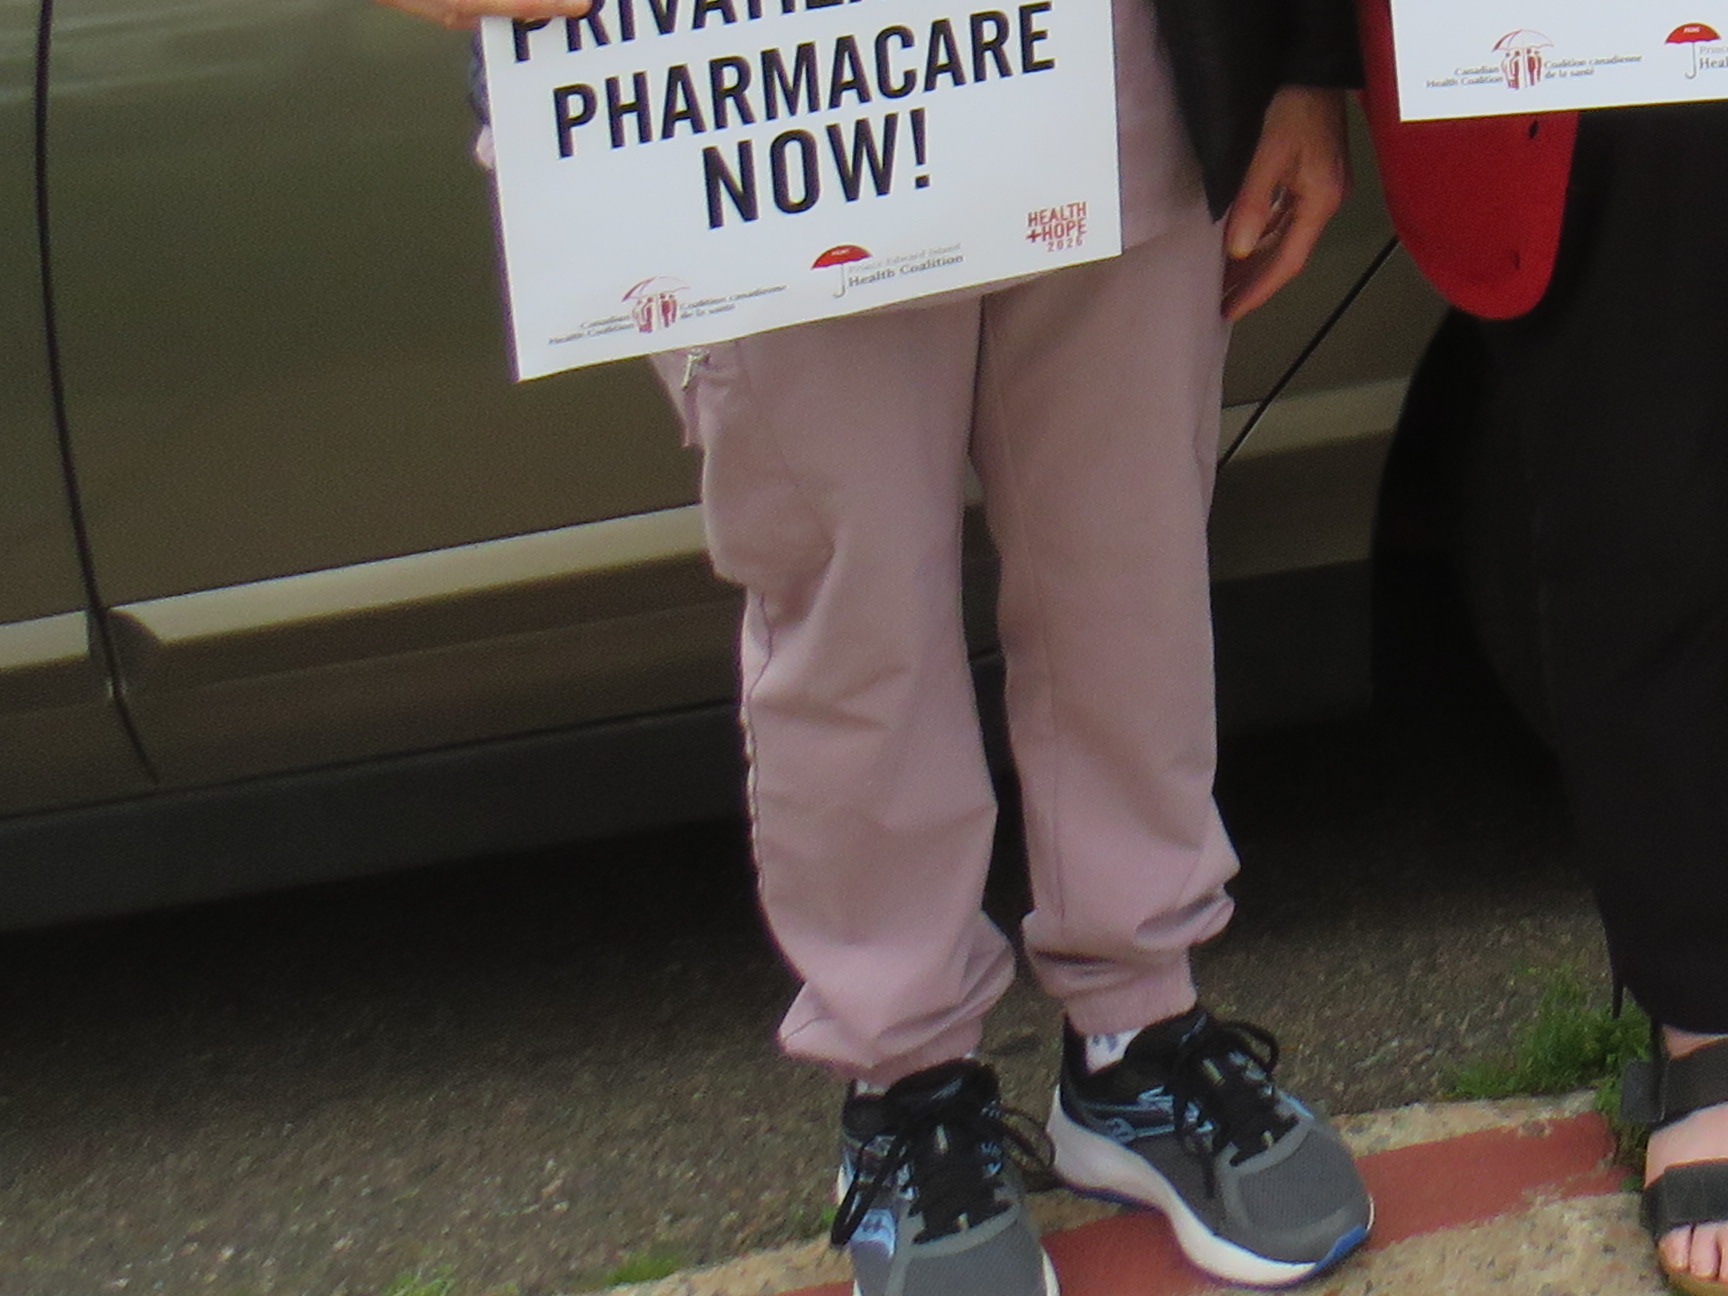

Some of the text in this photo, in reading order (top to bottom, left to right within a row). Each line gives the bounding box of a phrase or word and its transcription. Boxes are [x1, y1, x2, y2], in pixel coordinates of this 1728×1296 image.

[553, 1, 1056, 160] PHARMACARE
[703, 107, 932, 232] NOW!
[1028, 201, 1087, 227] HEALTH
[849, 254, 963, 287] Health Coalition
